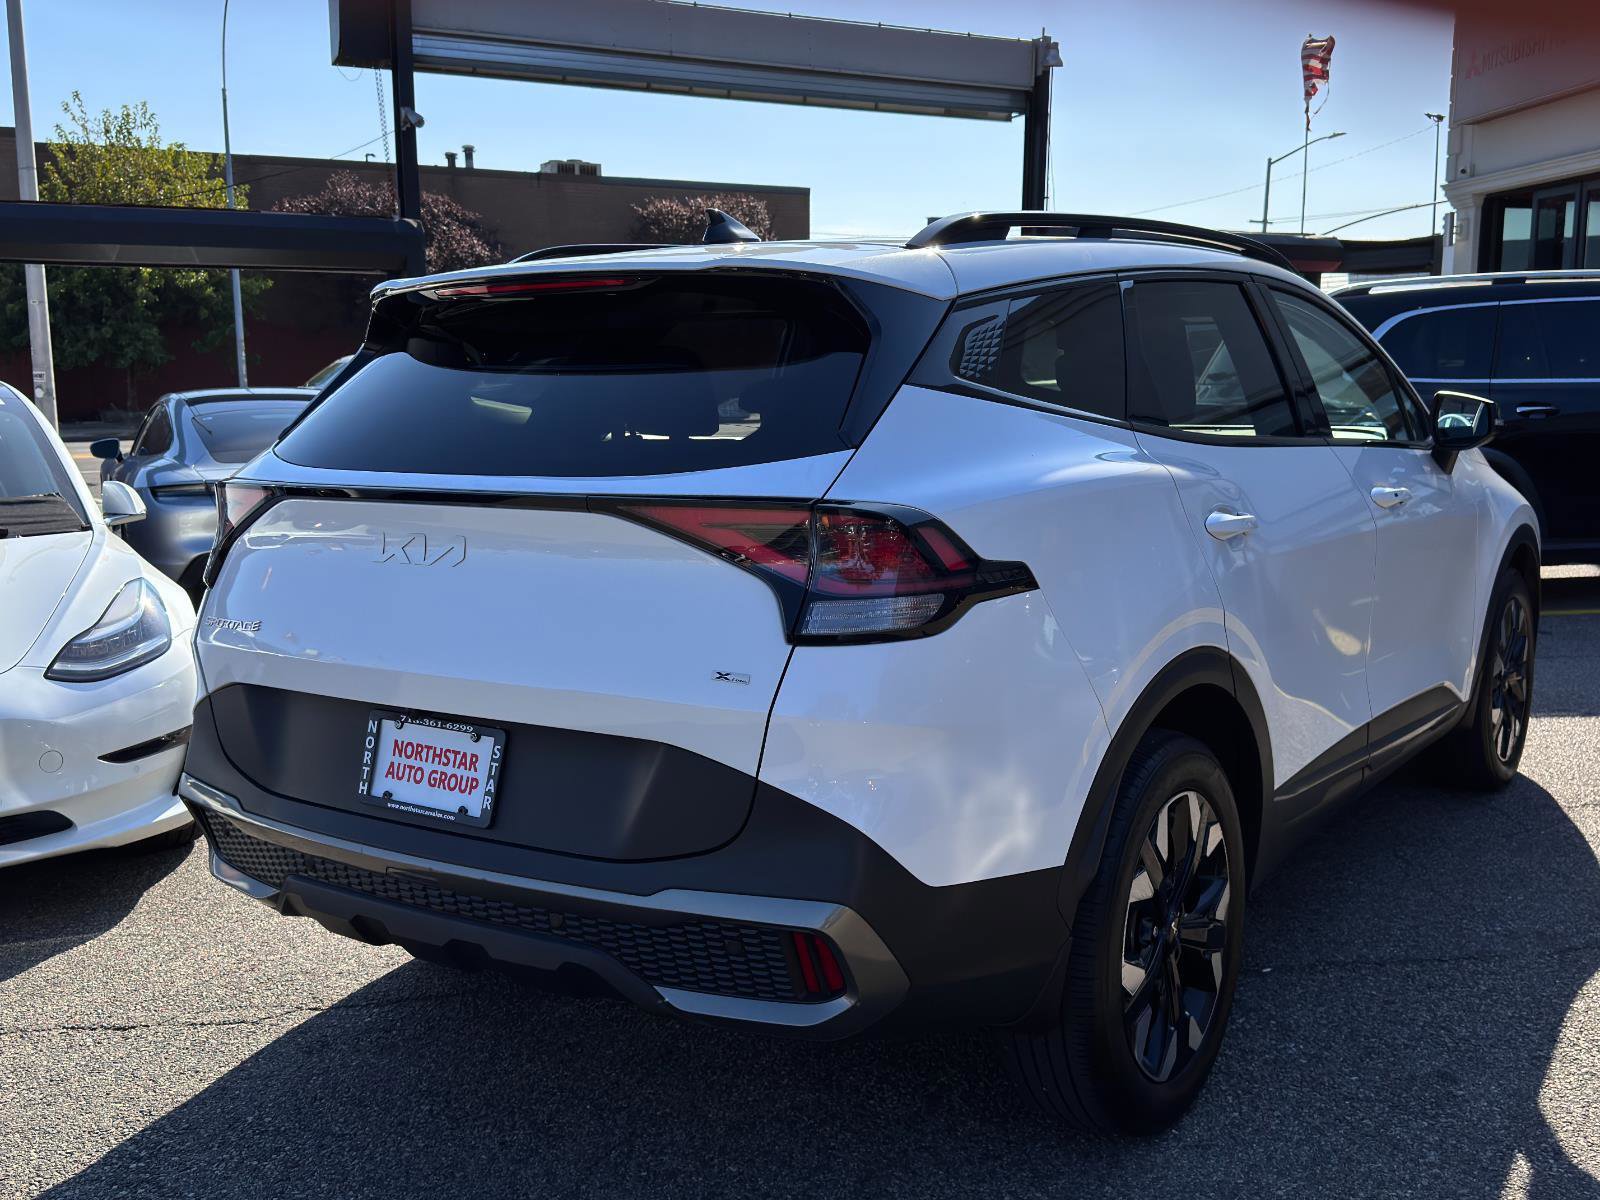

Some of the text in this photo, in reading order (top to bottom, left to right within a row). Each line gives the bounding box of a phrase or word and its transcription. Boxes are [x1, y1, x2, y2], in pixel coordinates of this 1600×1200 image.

[374, 531, 467, 568] KIA
[358, 720, 378, 795] NORTH
[392, 739, 480, 773] NORTHSTAR
[385, 761, 480, 796] AUTO GROUP
[483, 745, 502, 810] STAR
